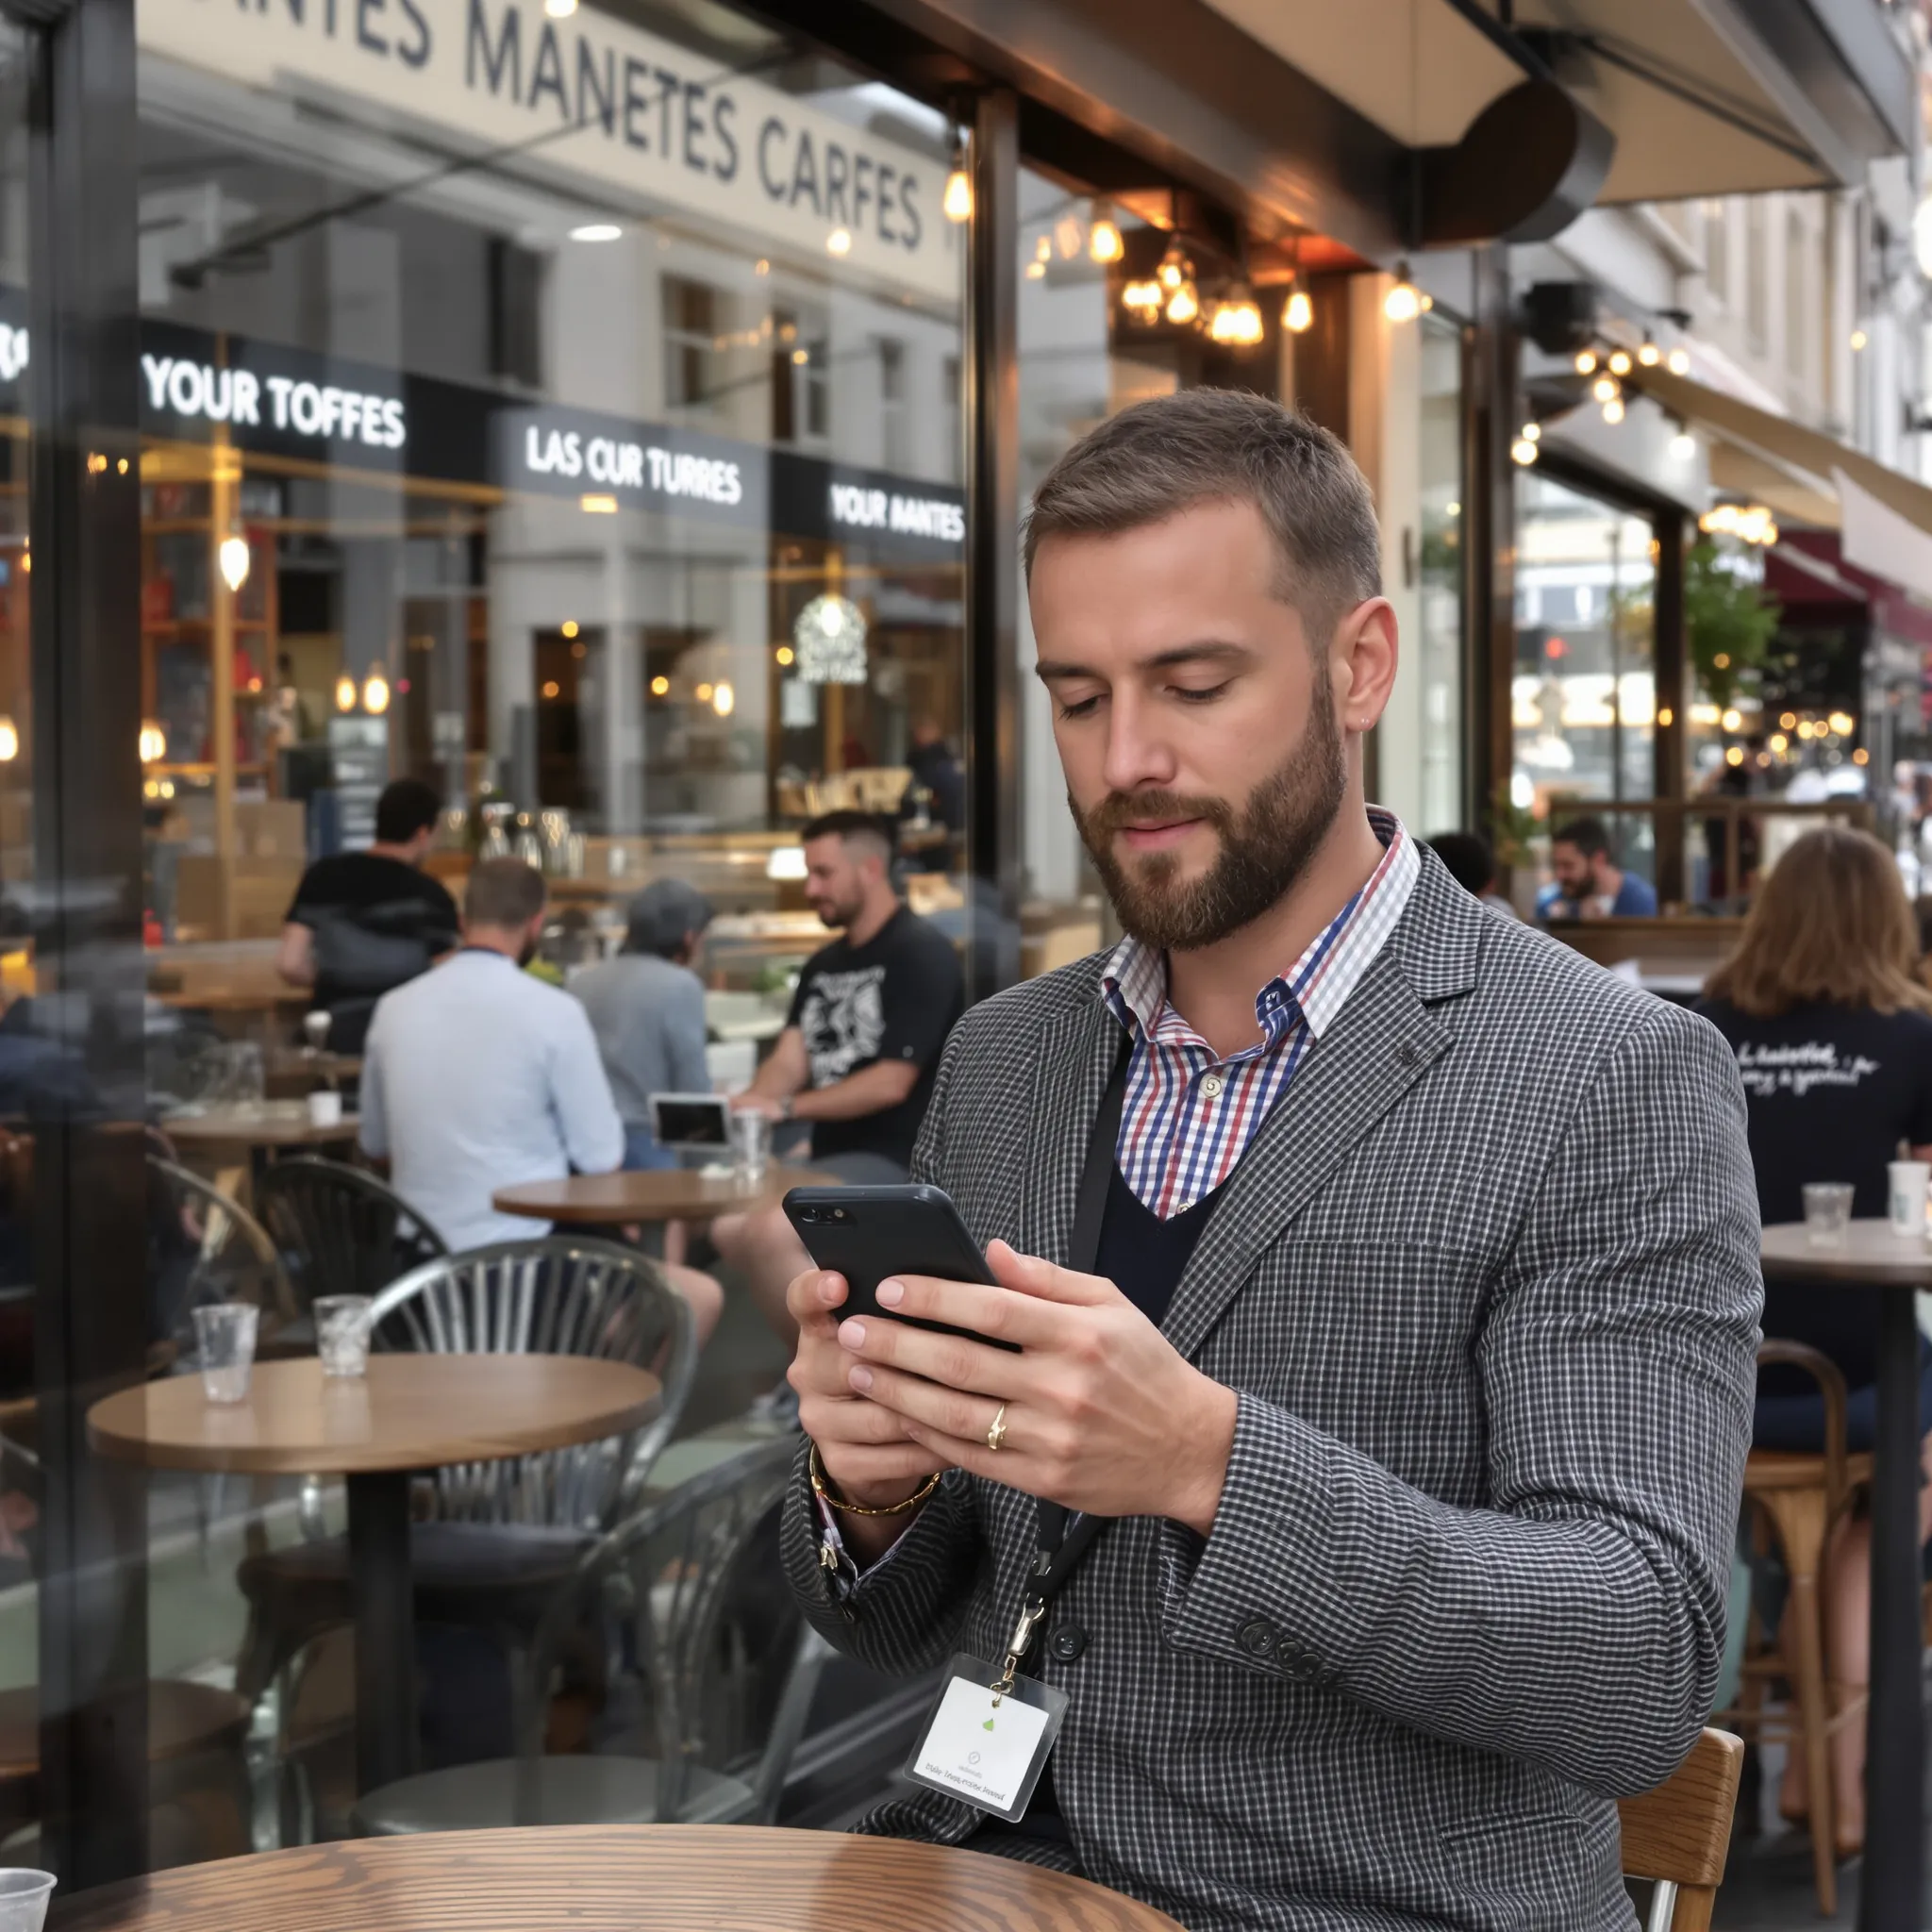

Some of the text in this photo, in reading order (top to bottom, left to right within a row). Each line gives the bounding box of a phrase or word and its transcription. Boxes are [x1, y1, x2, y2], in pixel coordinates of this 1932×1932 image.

[463, 0, 740, 185] MANETES
[757, 112, 923, 253] CARFES
[141, 353, 406, 449] YOUR TOFFES
[525, 425, 583, 478] LAS
[828, 483, 888, 527] YOUR
